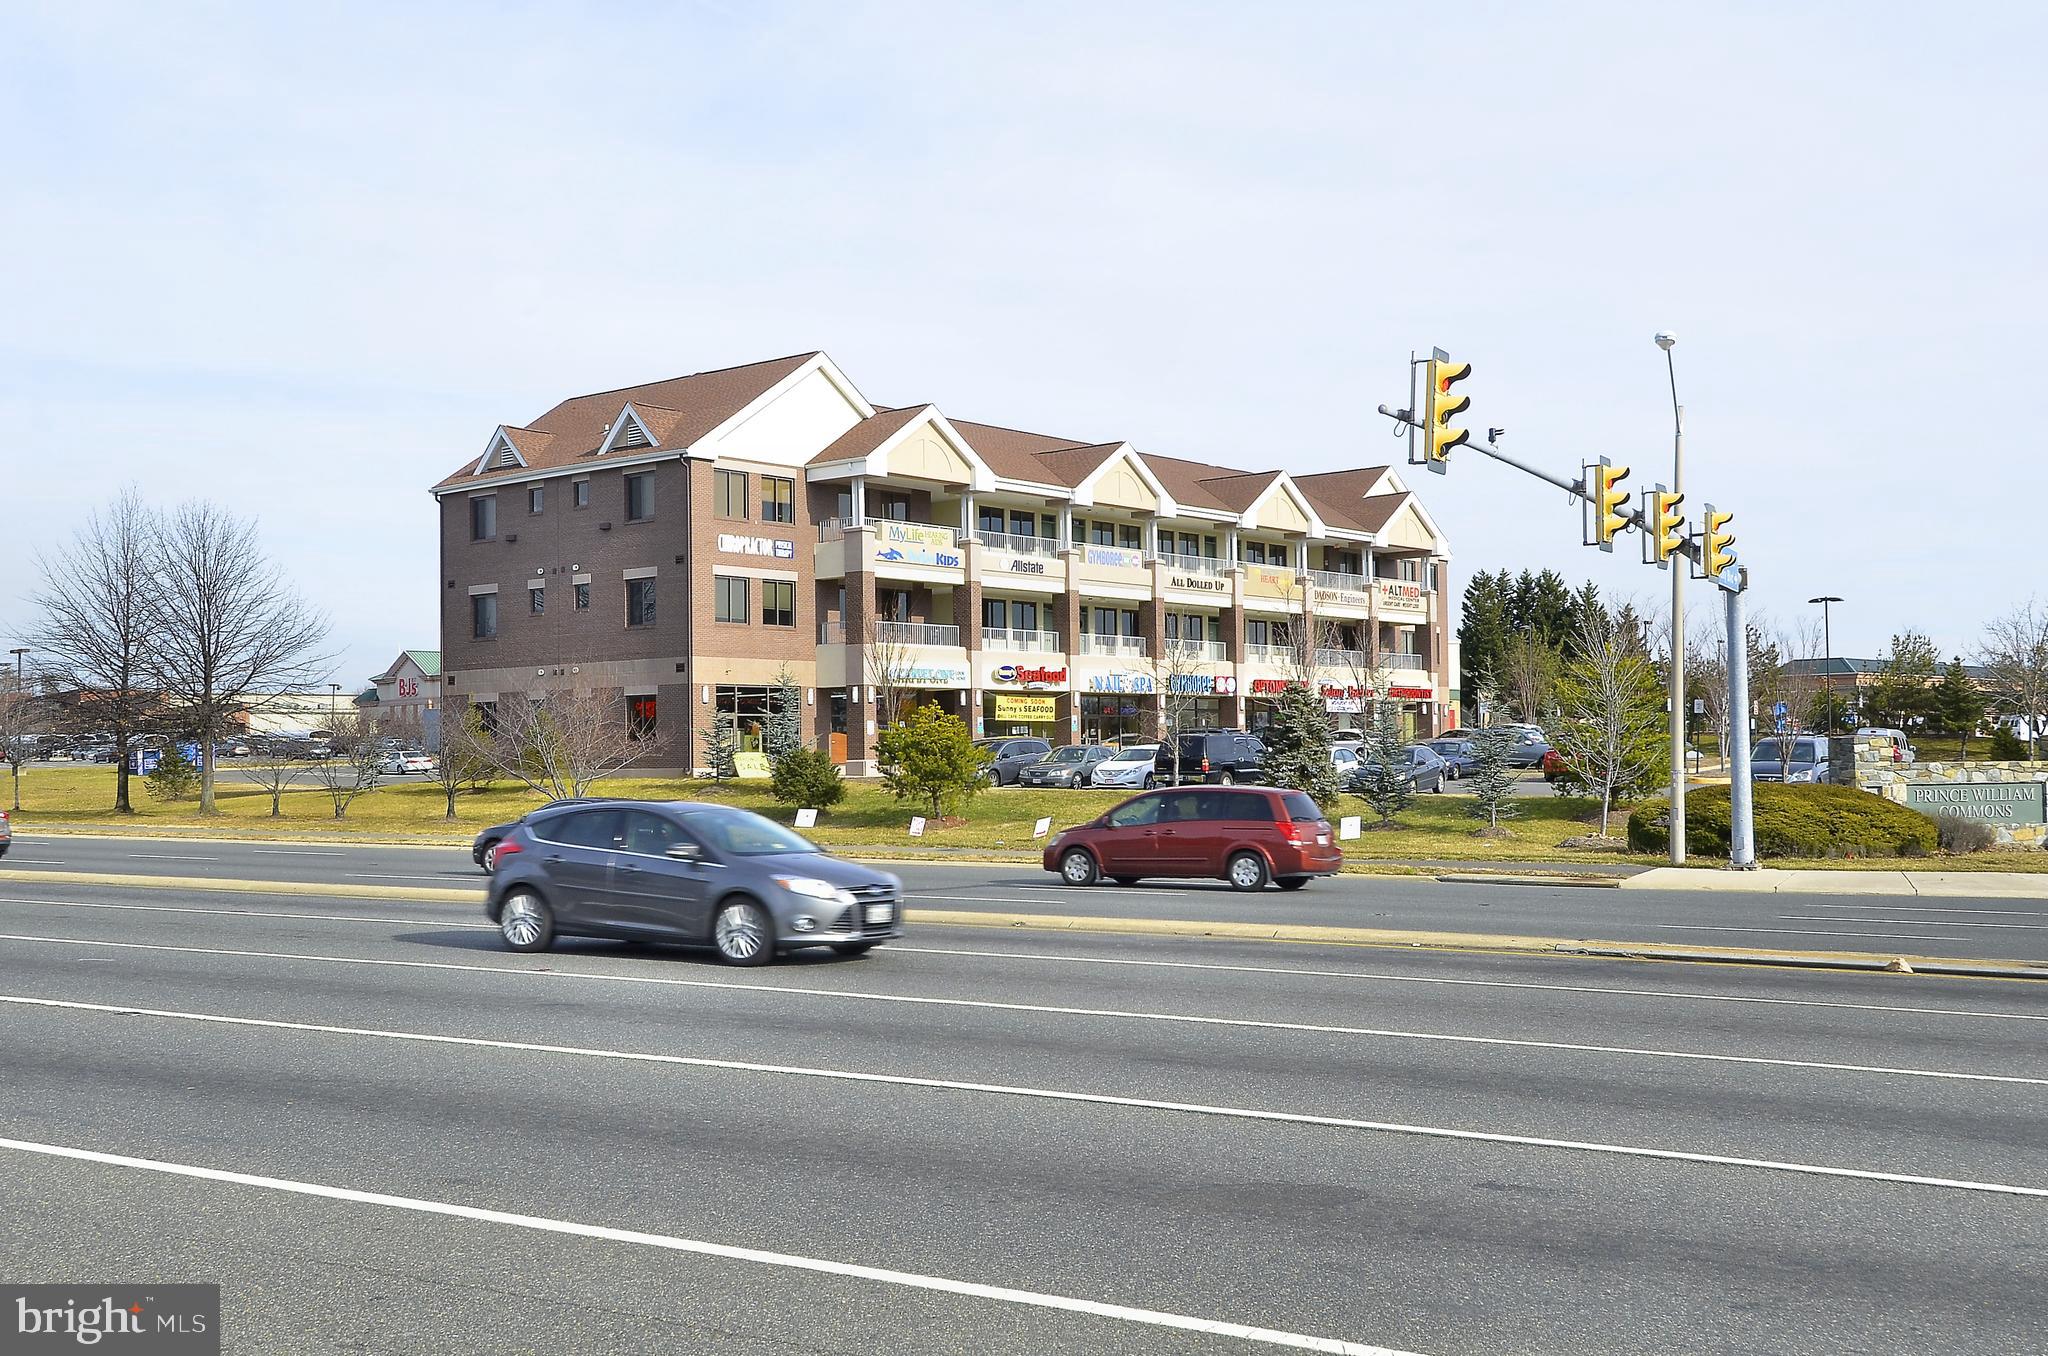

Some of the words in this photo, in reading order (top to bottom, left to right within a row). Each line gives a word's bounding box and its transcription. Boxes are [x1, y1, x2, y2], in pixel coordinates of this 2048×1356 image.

[889, 526, 924, 543] MyLife
[1010, 559, 1044, 574] Allstate
[1388, 584, 1420, 598] ALTMED
[1015, 665, 1067, 682] Seafood
[1133, 676, 1153, 693] SPA
[1023, 705, 1054, 713] SEAFOOD
[1914, 788, 1969, 803] PRINCE
[1971, 786, 2036, 801] WILLIAM
[1938, 804, 2013, 818] COMMONS
